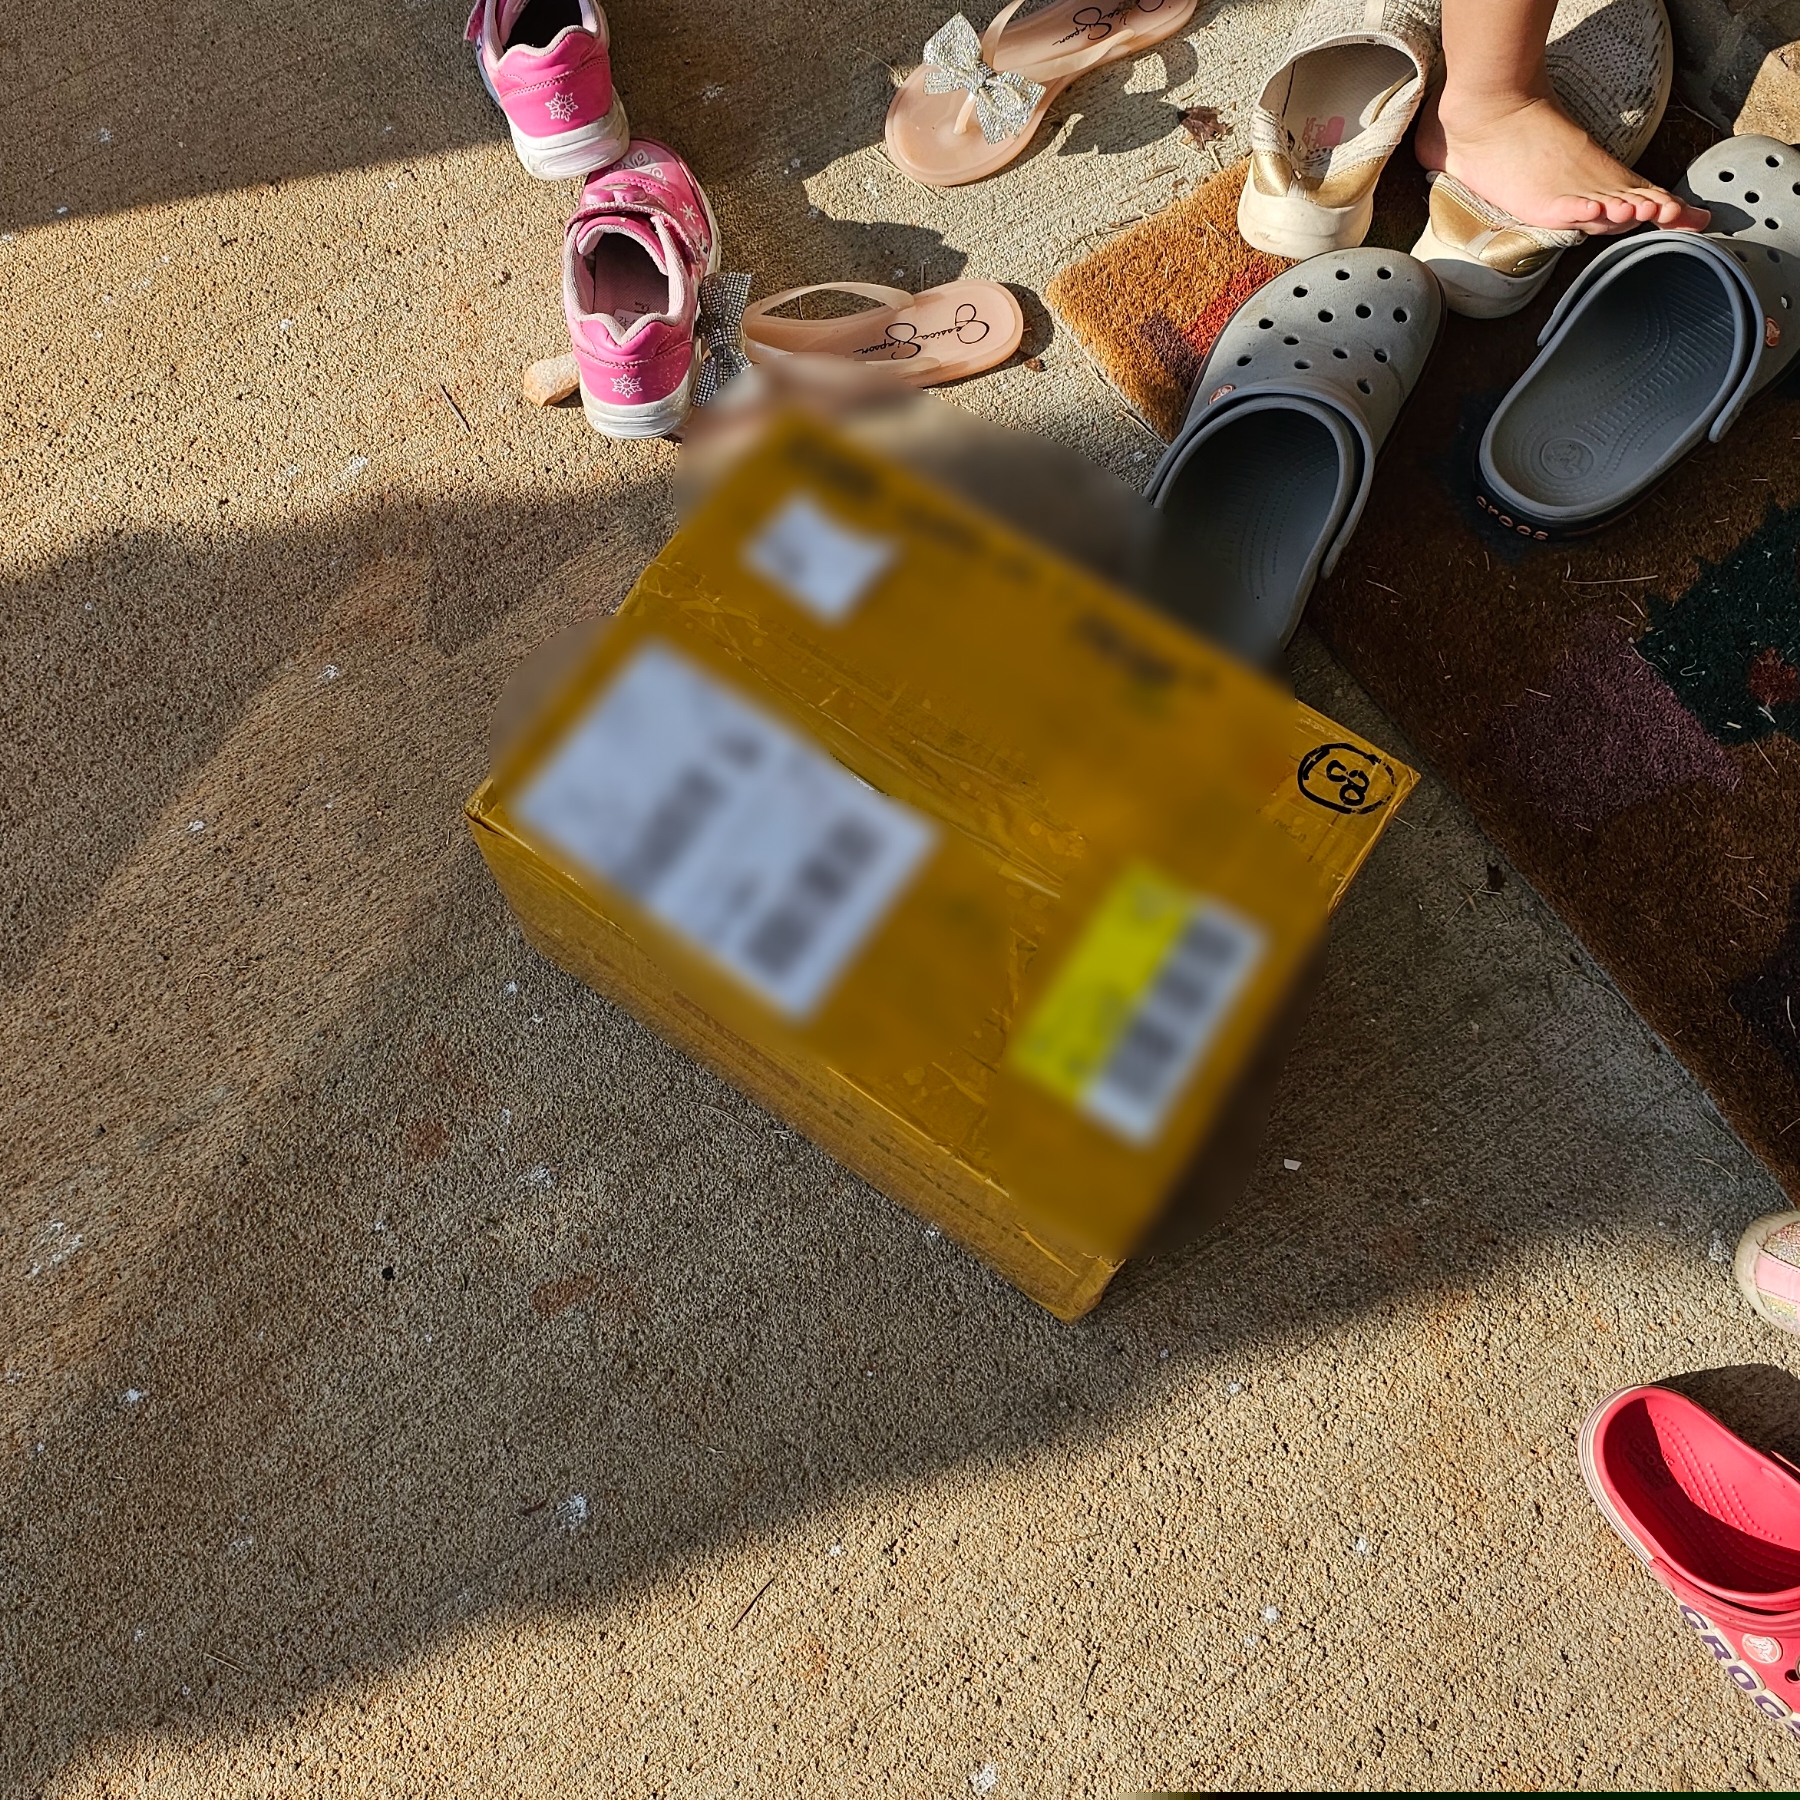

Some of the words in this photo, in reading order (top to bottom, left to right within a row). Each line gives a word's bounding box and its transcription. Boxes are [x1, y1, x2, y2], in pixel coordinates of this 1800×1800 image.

[853, 322, 922, 360] Simpson
[914, 303, 990, 344] Jessica
[1476, 495, 1549, 540] crocs
